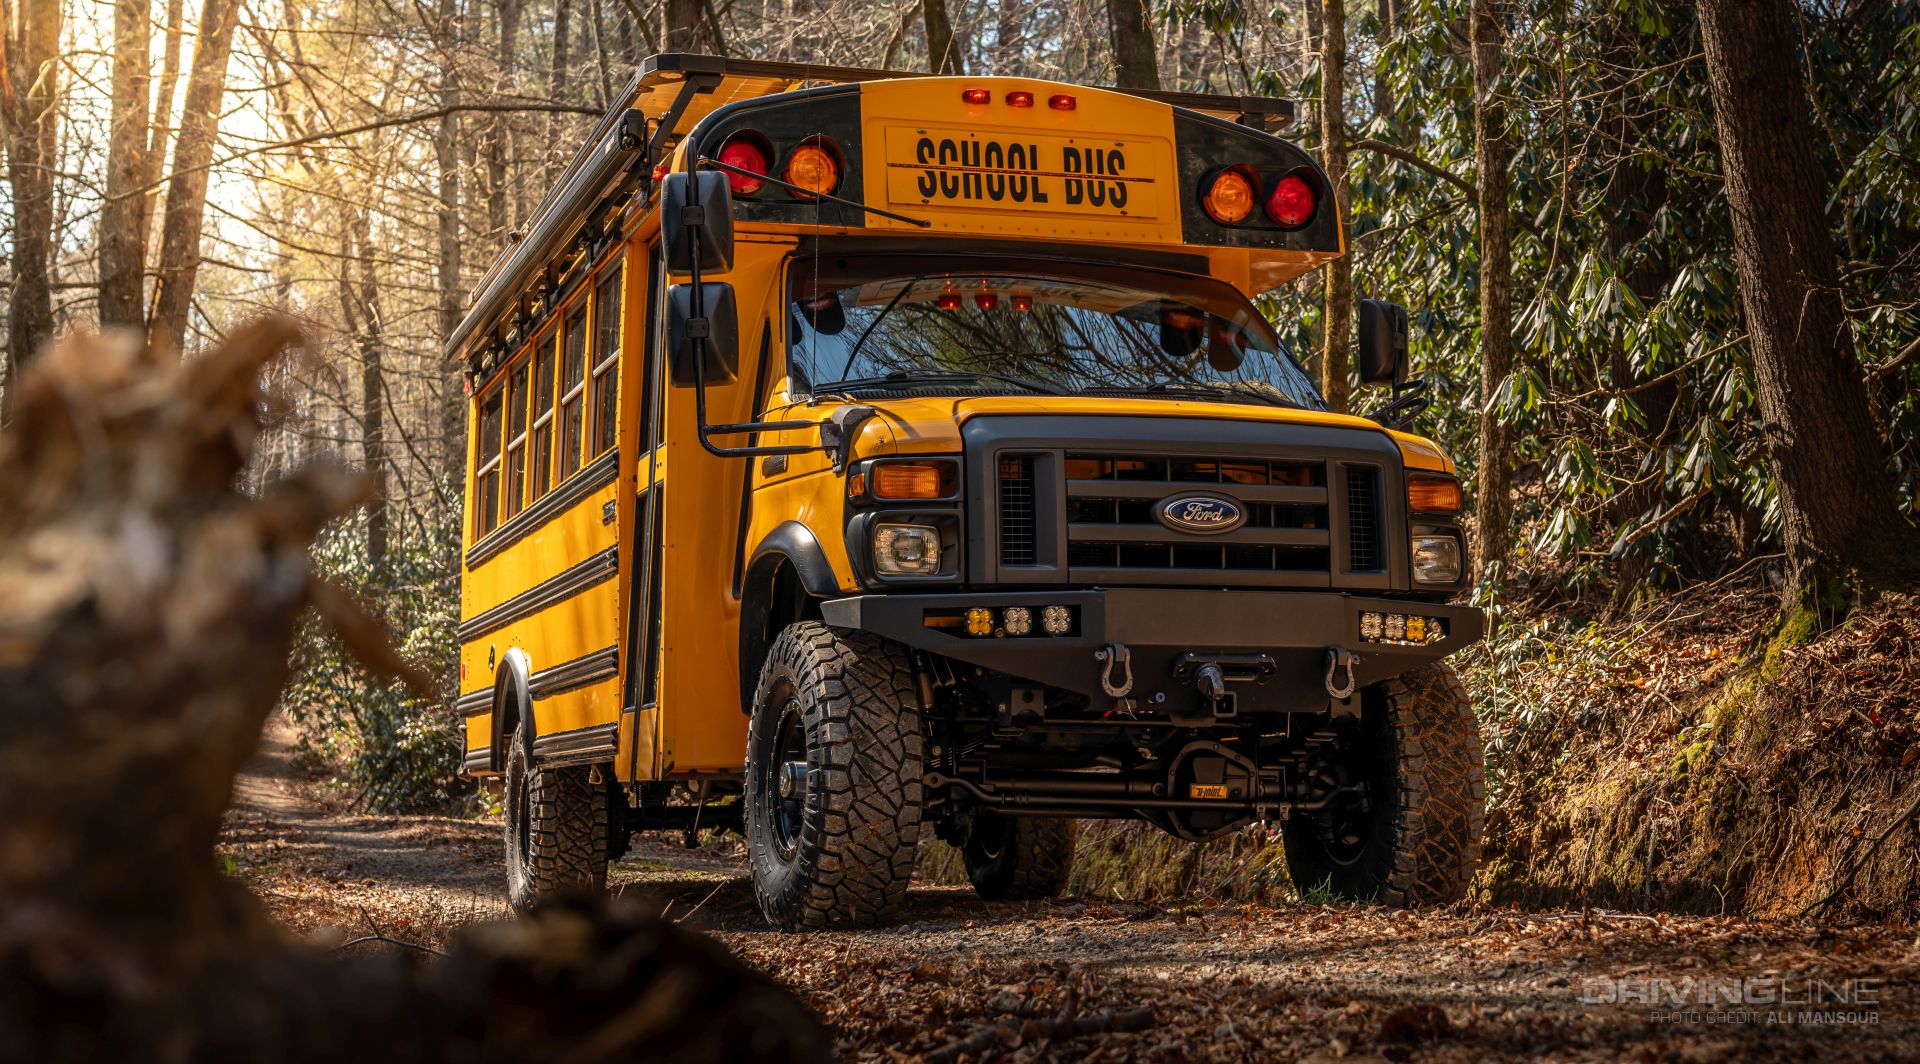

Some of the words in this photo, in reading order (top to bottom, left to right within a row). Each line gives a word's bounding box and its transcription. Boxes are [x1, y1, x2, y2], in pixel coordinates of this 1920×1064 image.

[916, 137, 1049, 204] SCHOOL
[1062, 146, 1128, 209] BUS
[1183, 502, 1224, 521] Ford
